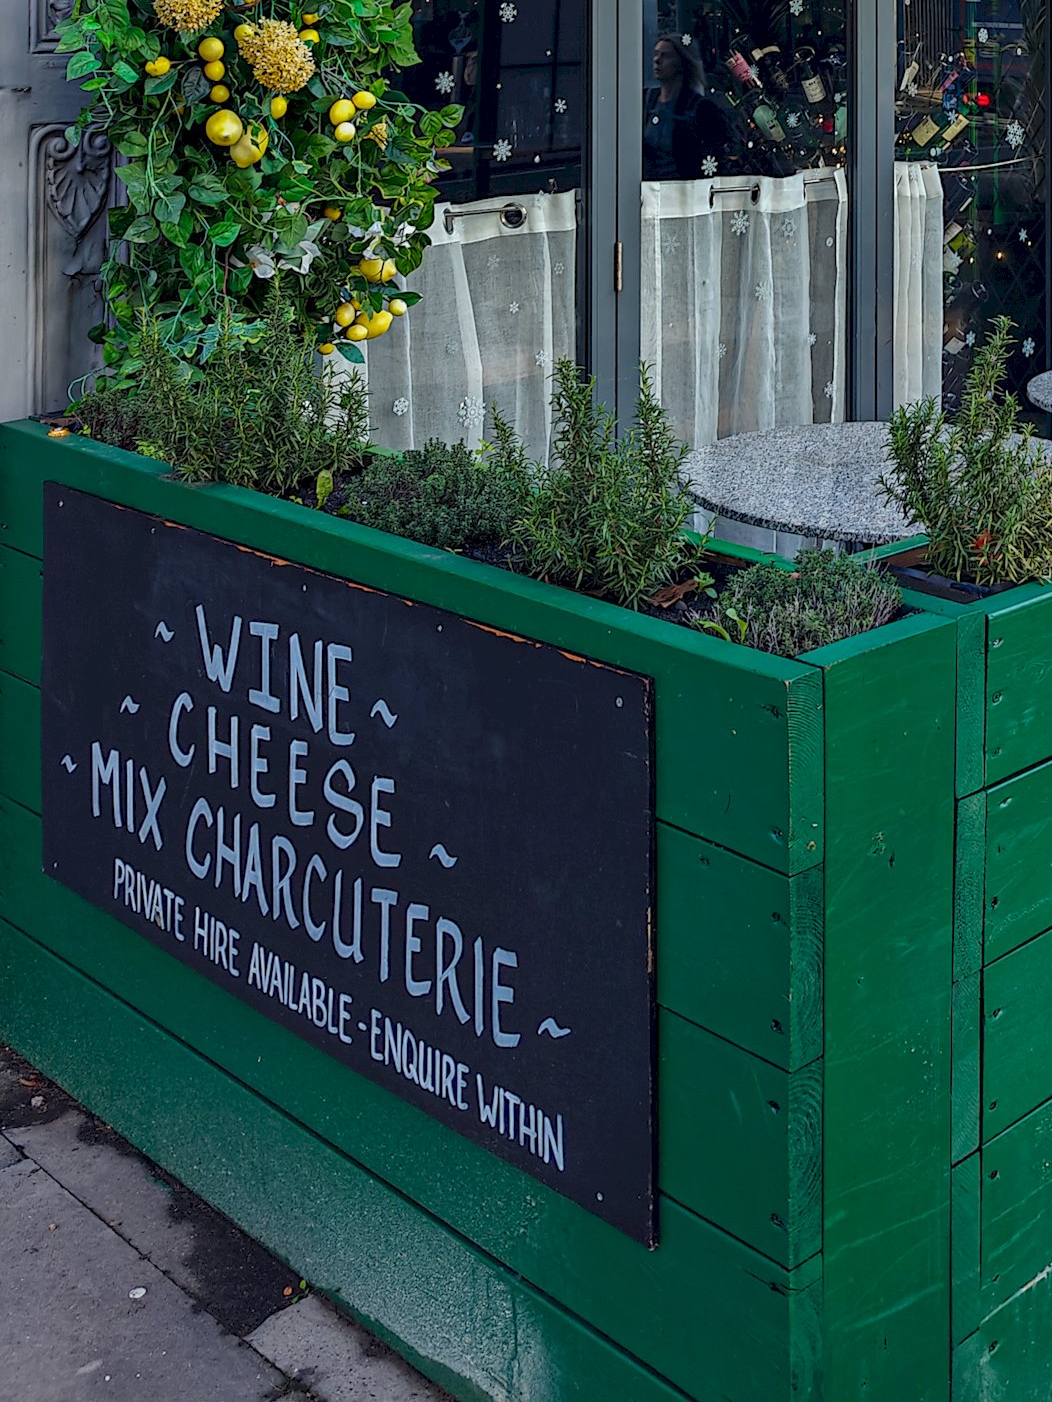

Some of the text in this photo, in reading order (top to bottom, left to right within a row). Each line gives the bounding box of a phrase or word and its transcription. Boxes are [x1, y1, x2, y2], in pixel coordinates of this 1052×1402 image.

[169, 692, 401, 868] CHEESE
[196, 604, 355, 746] WINE
[91, 741, 521, 1048] MIX CHARCUTERIE
[113, 858, 185, 942] PRIVATE
[194, 906, 240, 977] HIRE
[248, 942, 352, 1044] AVAILABLE
[370, 1008, 470, 1111] ENQUIRE
[476, 1073, 565, 1172] WITHIN
